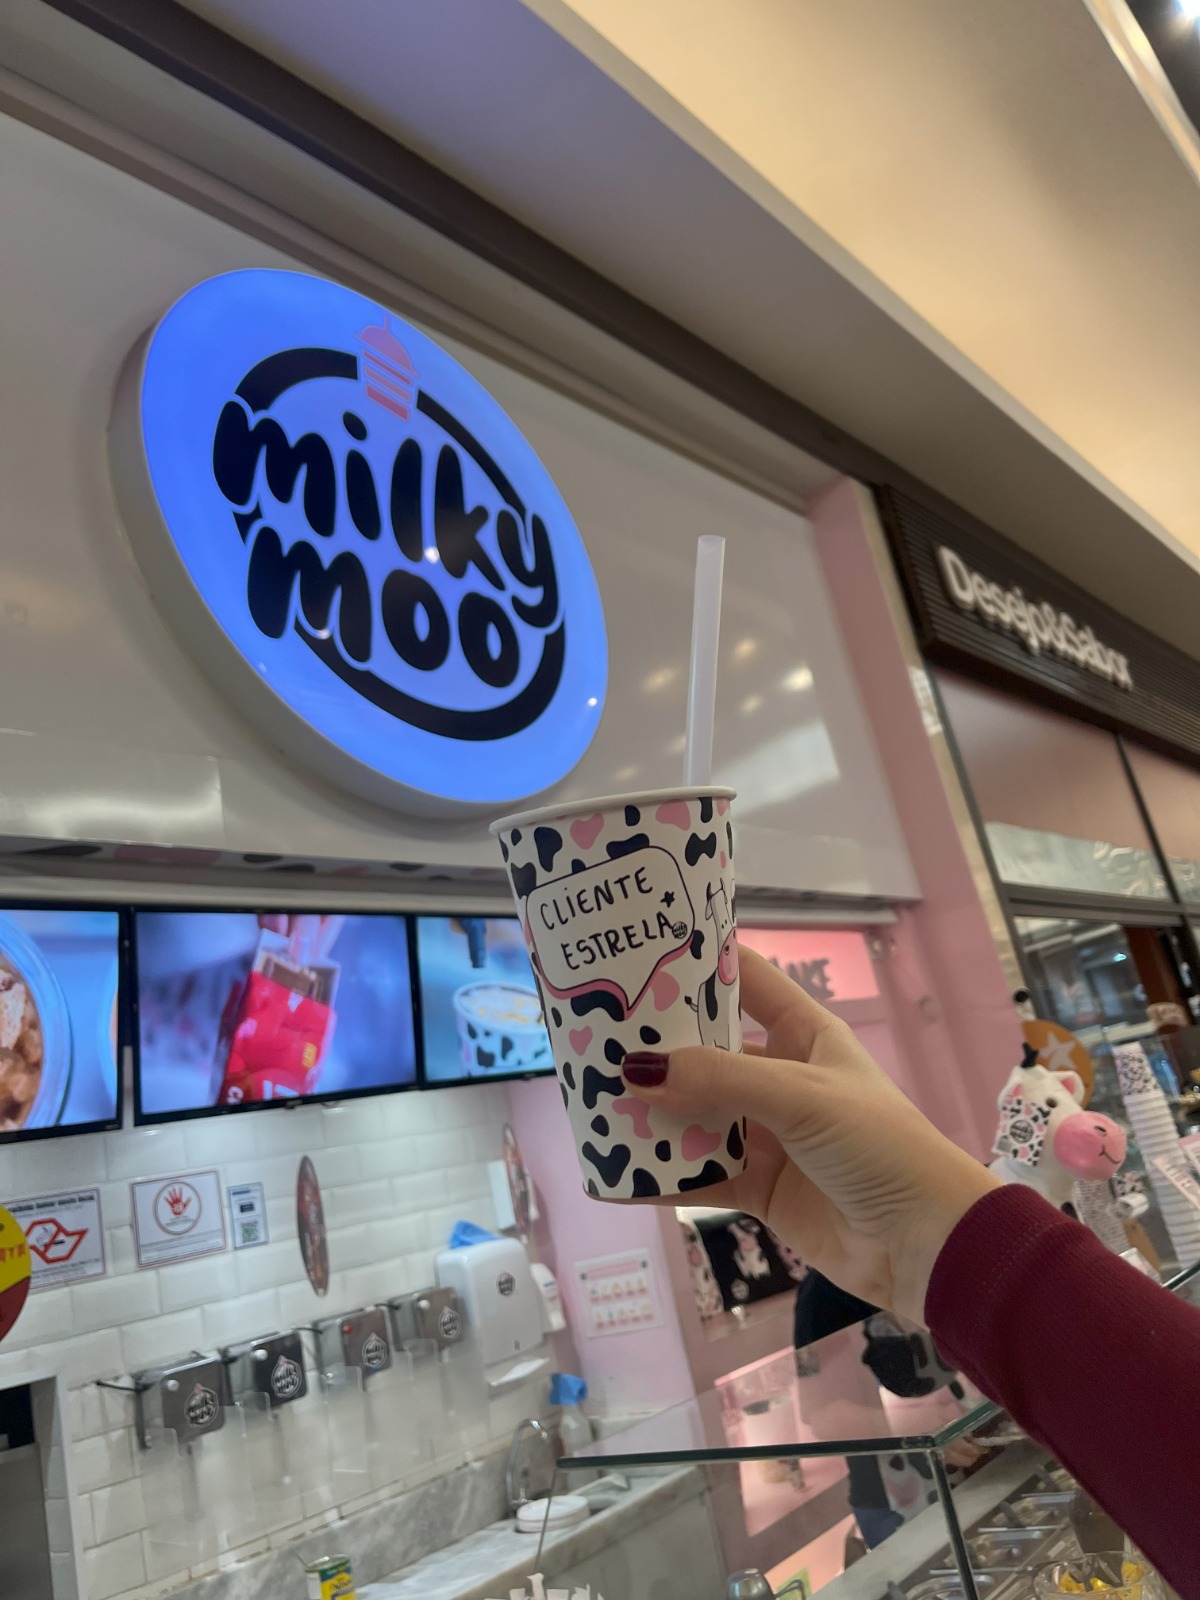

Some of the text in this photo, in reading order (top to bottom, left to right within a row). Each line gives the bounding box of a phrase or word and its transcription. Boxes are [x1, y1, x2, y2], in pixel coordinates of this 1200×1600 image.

[213, 400, 558, 628] milky
[247, 526, 520, 688] moo
[561, 911, 673, 970] ESTRELA
